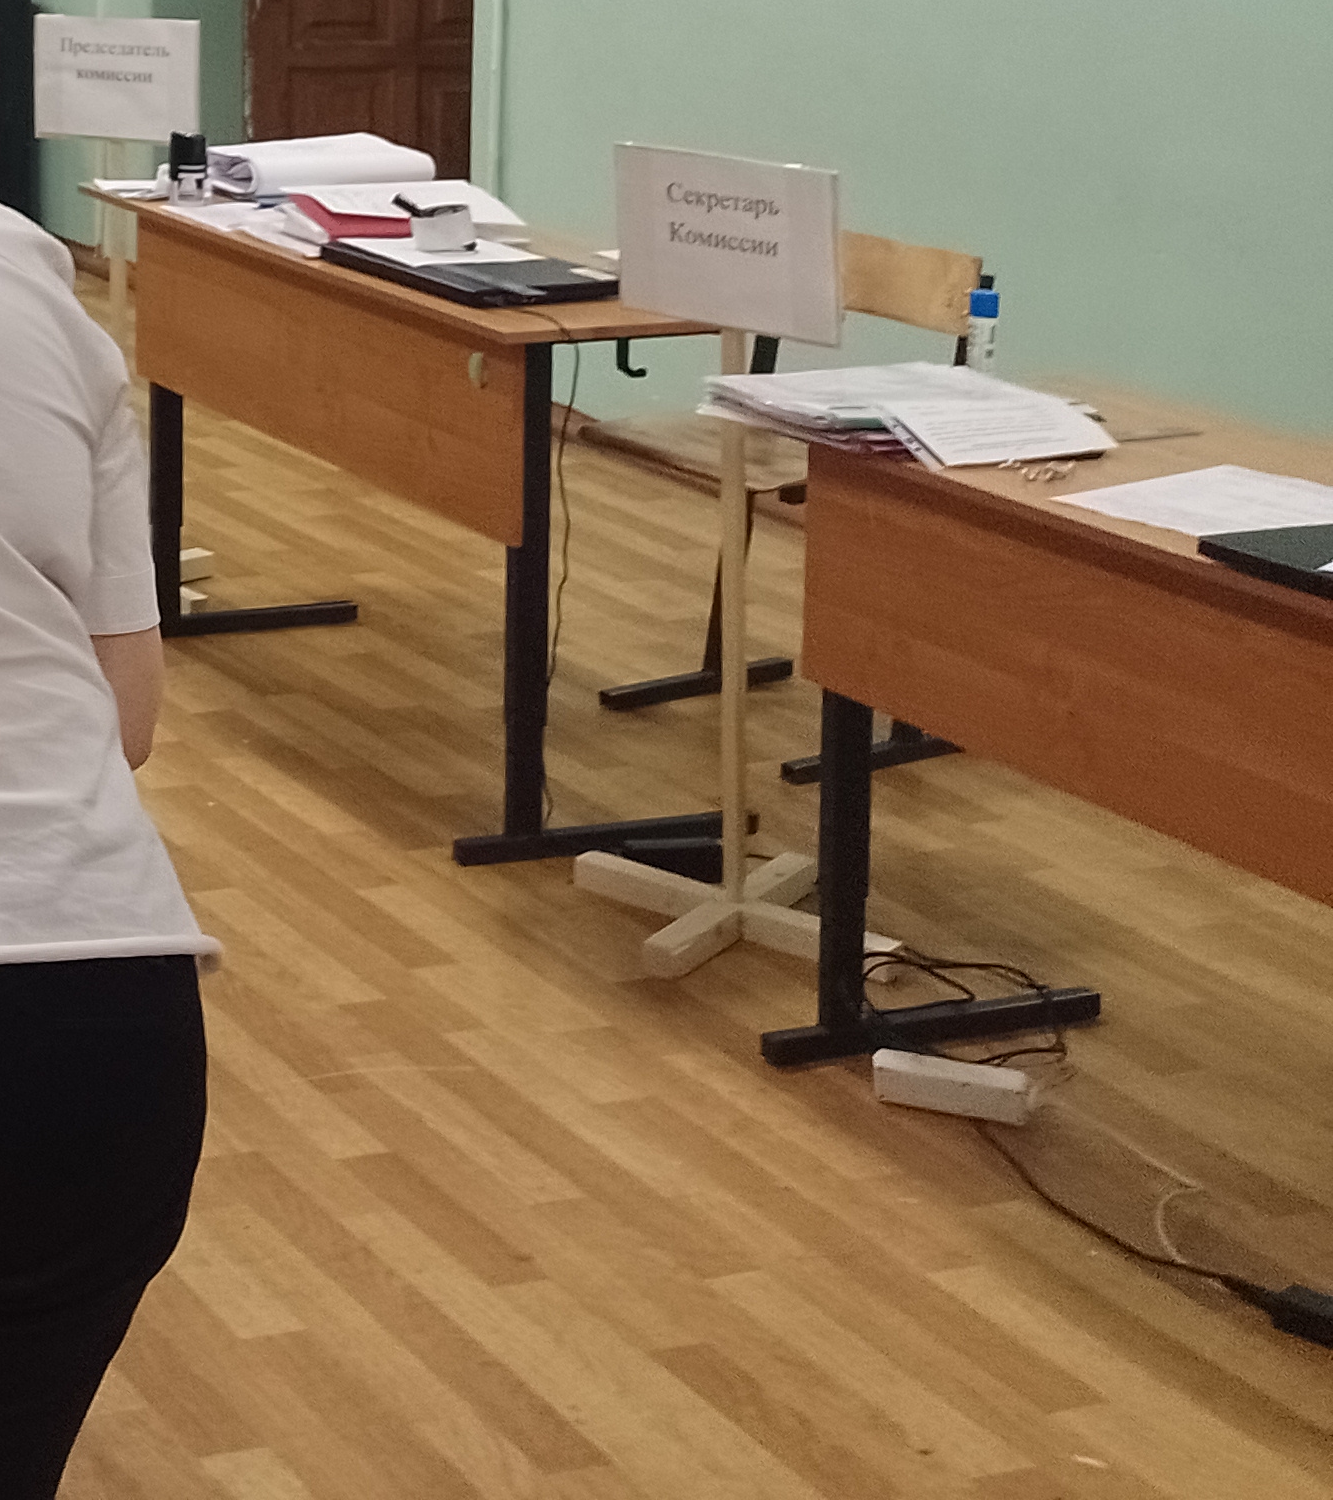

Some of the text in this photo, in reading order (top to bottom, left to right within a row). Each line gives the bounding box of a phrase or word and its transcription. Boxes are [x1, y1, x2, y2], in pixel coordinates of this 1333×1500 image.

[60, 37, 170, 57] Председатель
[76, 68, 153, 83] комиссии
[666, 182, 781, 219] Секретарь
[669, 221, 779, 257] Комиссии
